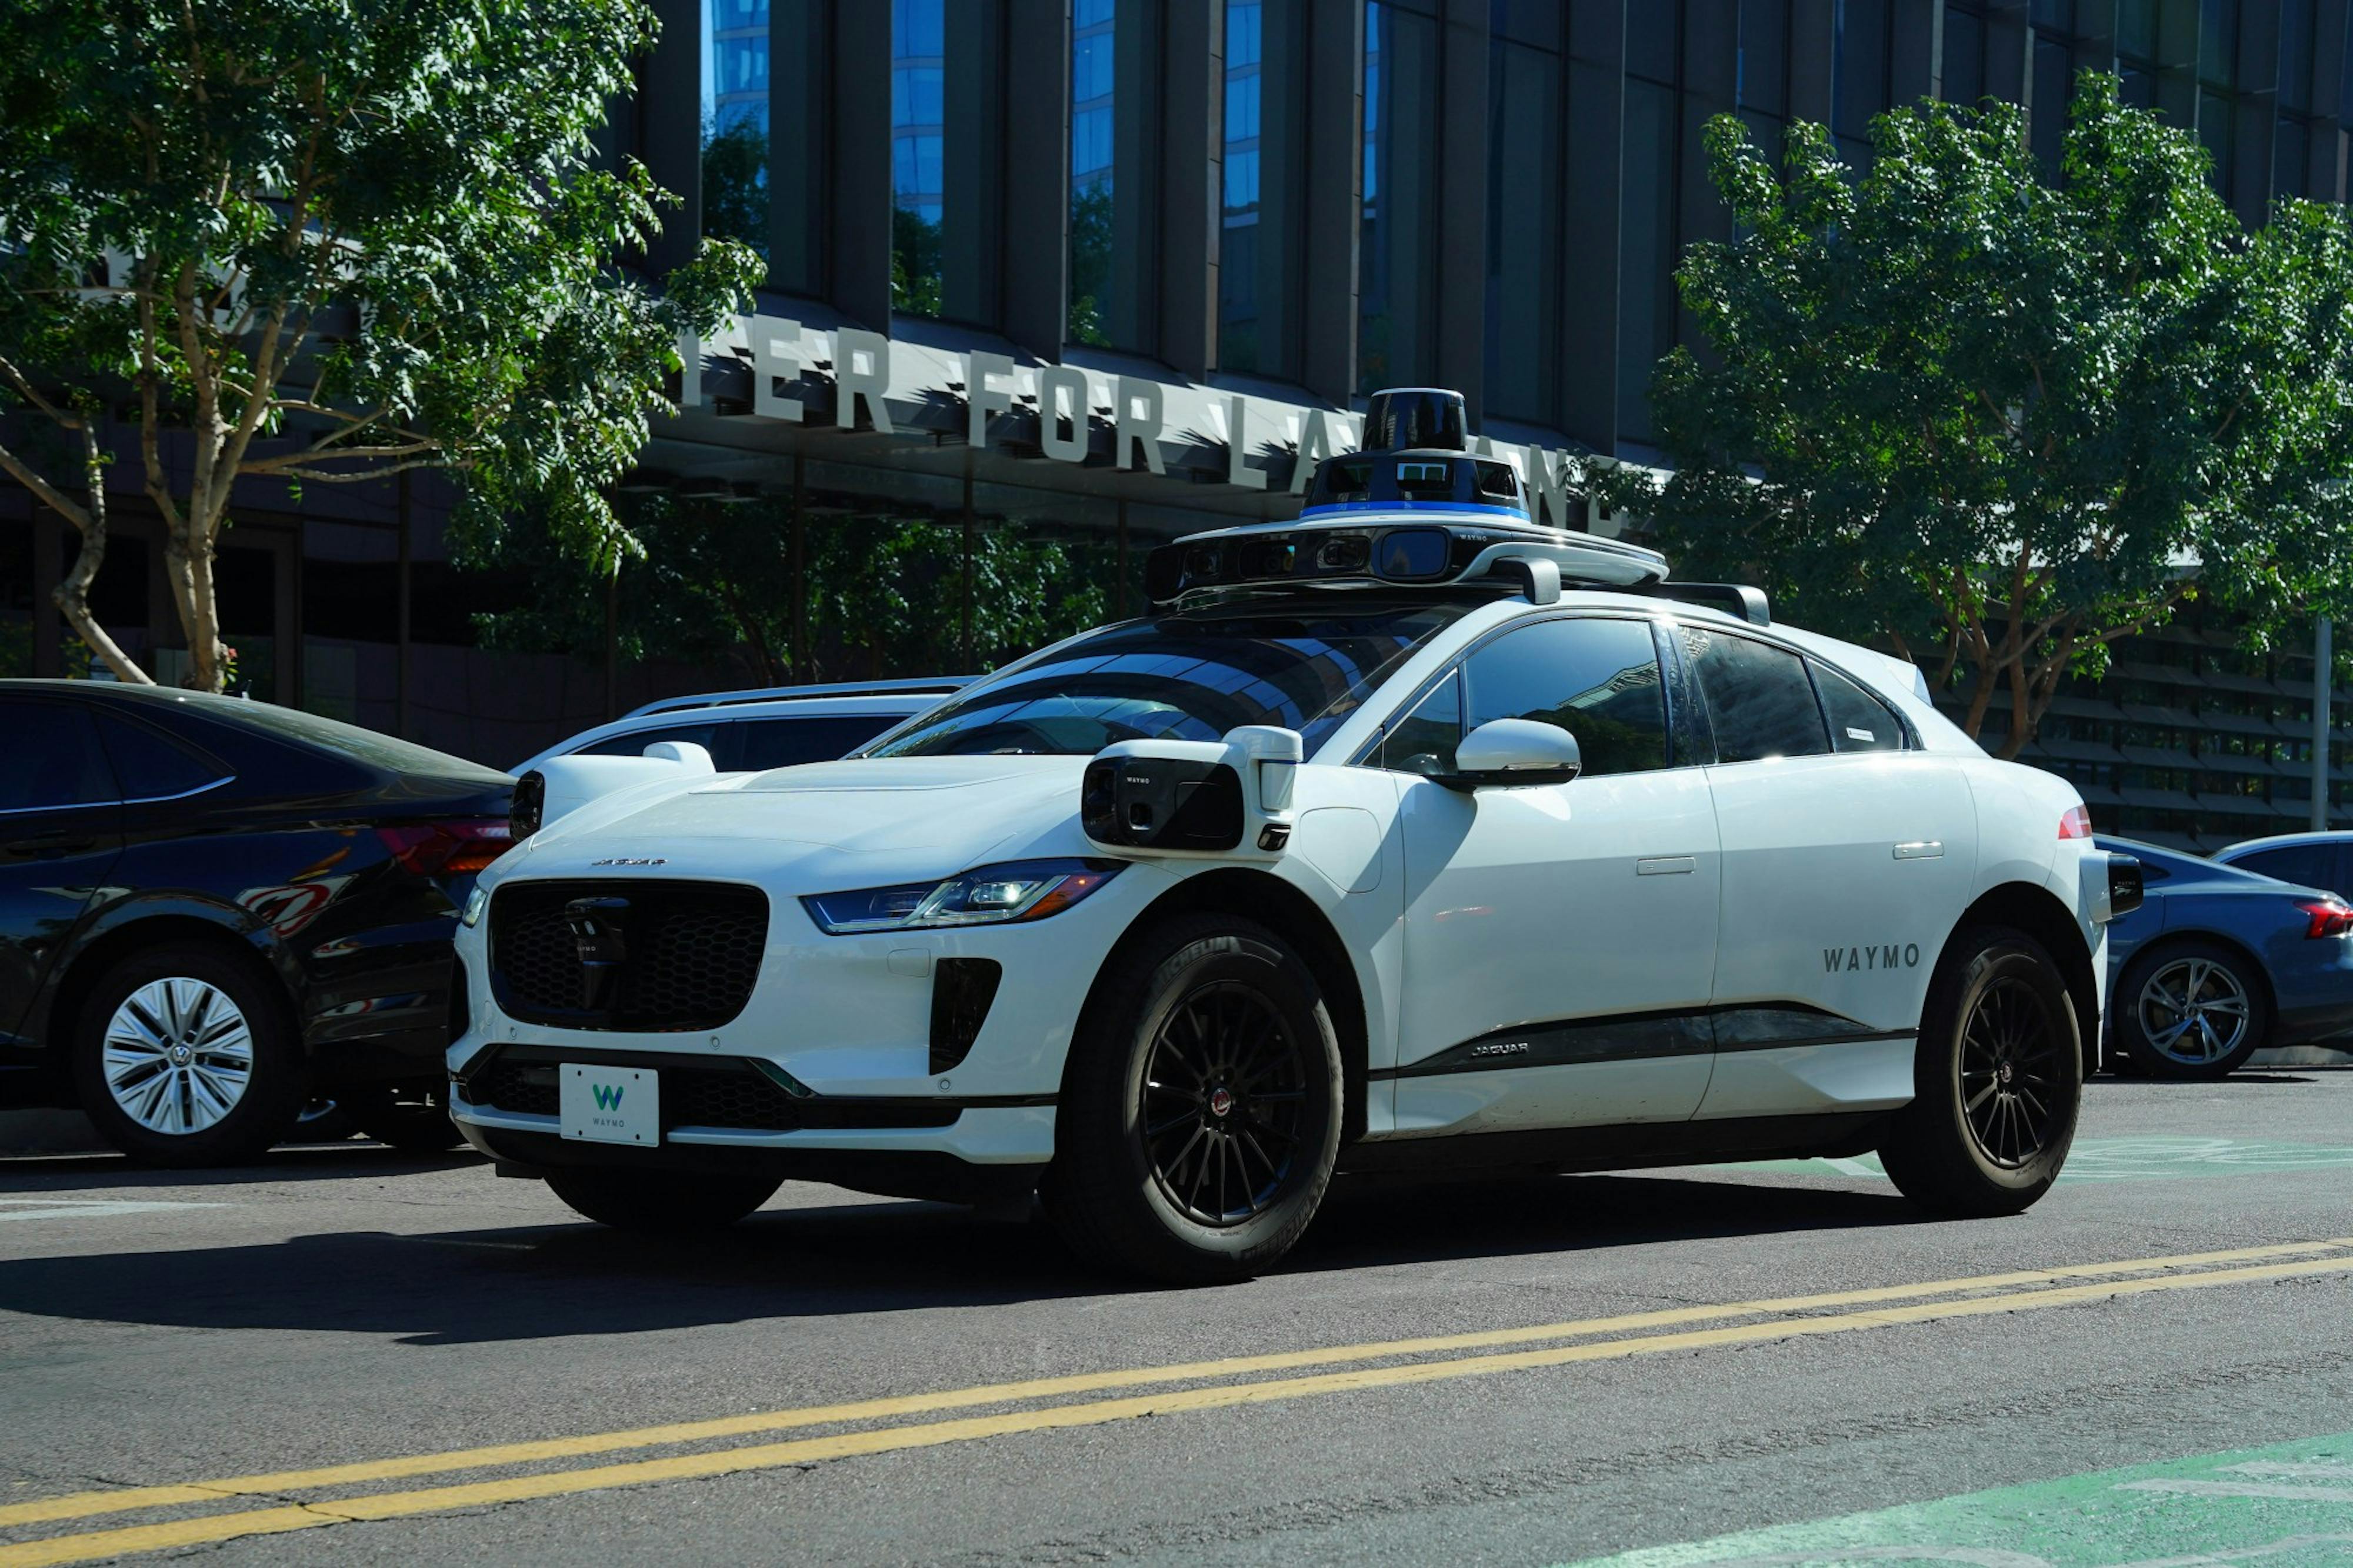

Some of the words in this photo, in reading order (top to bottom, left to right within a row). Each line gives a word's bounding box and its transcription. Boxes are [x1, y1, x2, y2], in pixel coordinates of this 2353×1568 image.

[969, 349, 1166, 475] FOR
[1229, 396, 1366, 495] LA
[1459, 534, 1487, 542] WAYMO
[1823, 943, 1919, 972] WAYMO
[1471, 1042, 1529, 1057] JAGUAR
[592, 1117, 625, 1127] WAYMO
